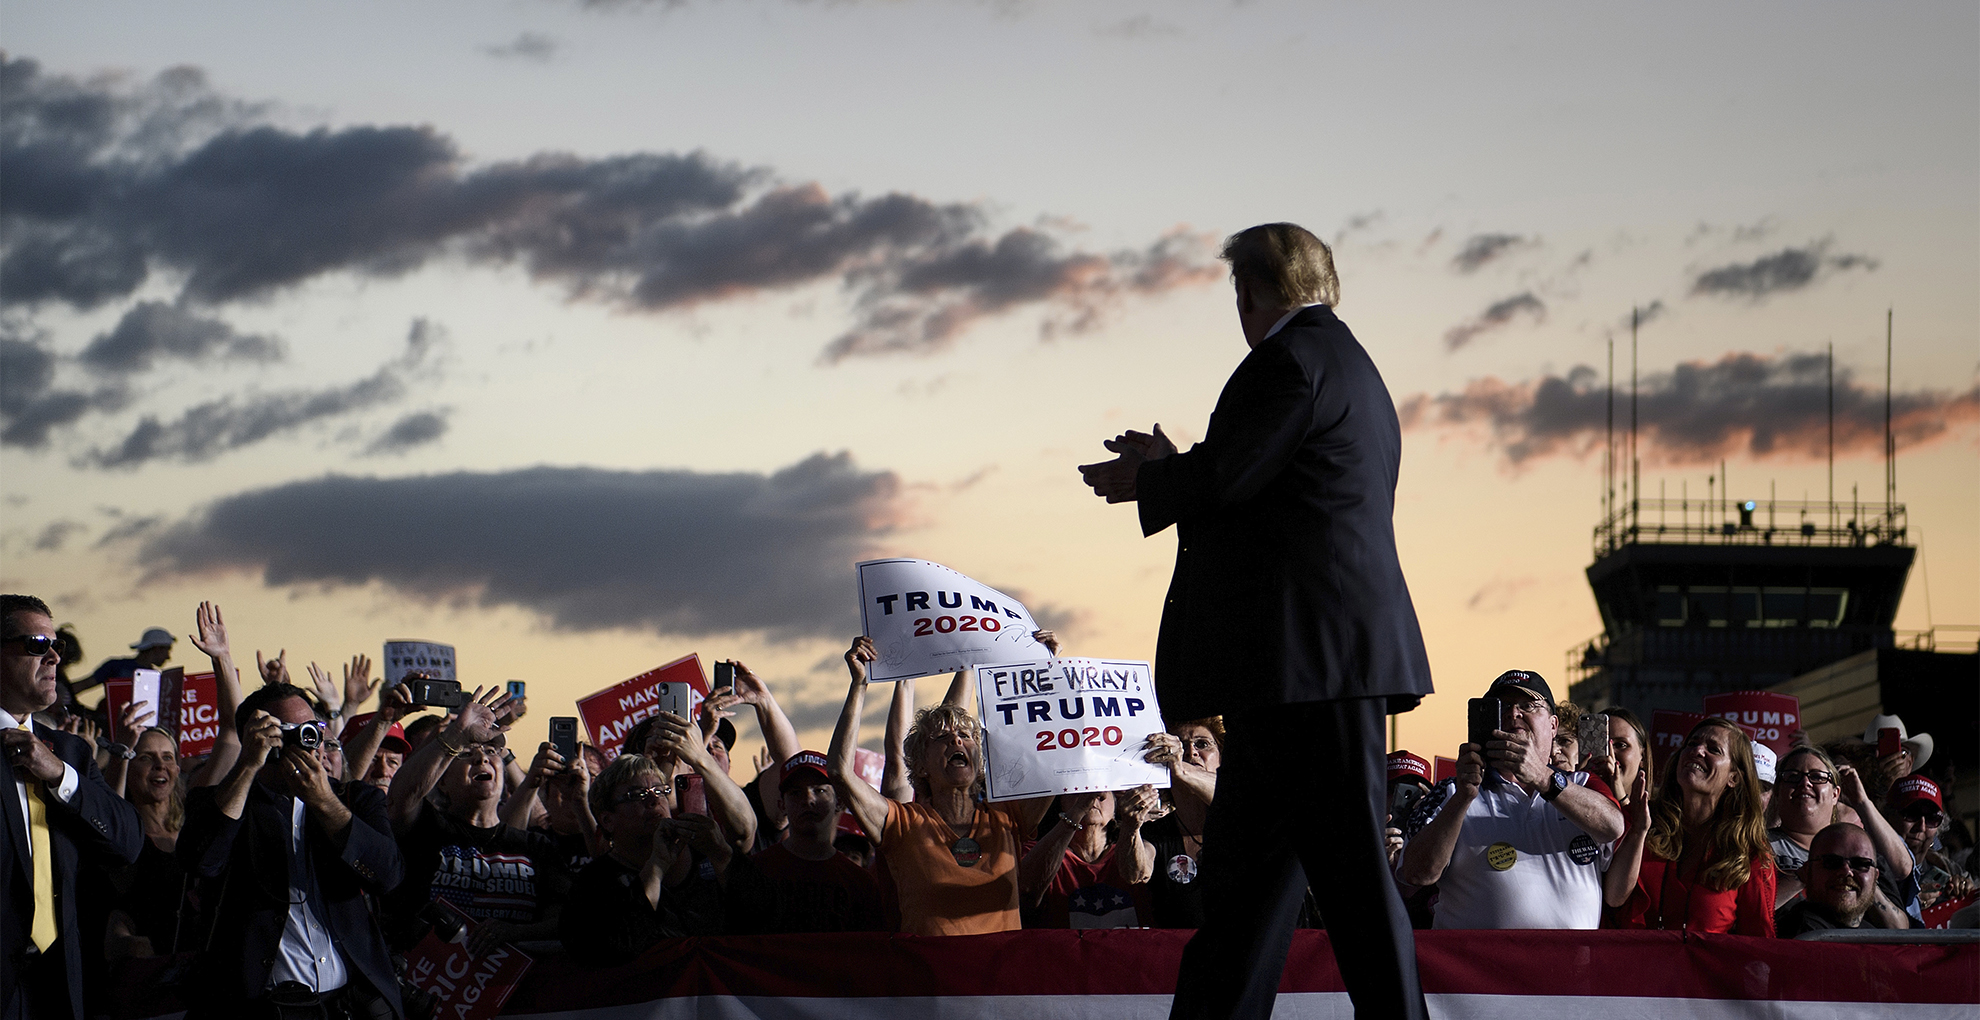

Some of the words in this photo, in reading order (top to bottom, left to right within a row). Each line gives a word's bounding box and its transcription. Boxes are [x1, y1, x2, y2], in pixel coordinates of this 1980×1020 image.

[876, 590, 1022, 620] TRUMP
[913, 615, 1001, 638] 2020
[391, 656, 451, 668] TRUMP
[619, 683, 660, 711] MAK
[996, 696, 1146, 725] TRUMP
[1035, 725, 1123, 751] 2020
[1756, 727, 1780, 741] 20
[784, 754, 827, 771] TRUMP
[438, 850, 536, 881] TRUMP
[431, 870, 470, 889] 2020
[471, 879, 486, 891] THE
[485, 878, 537, 897] SEQUEL
